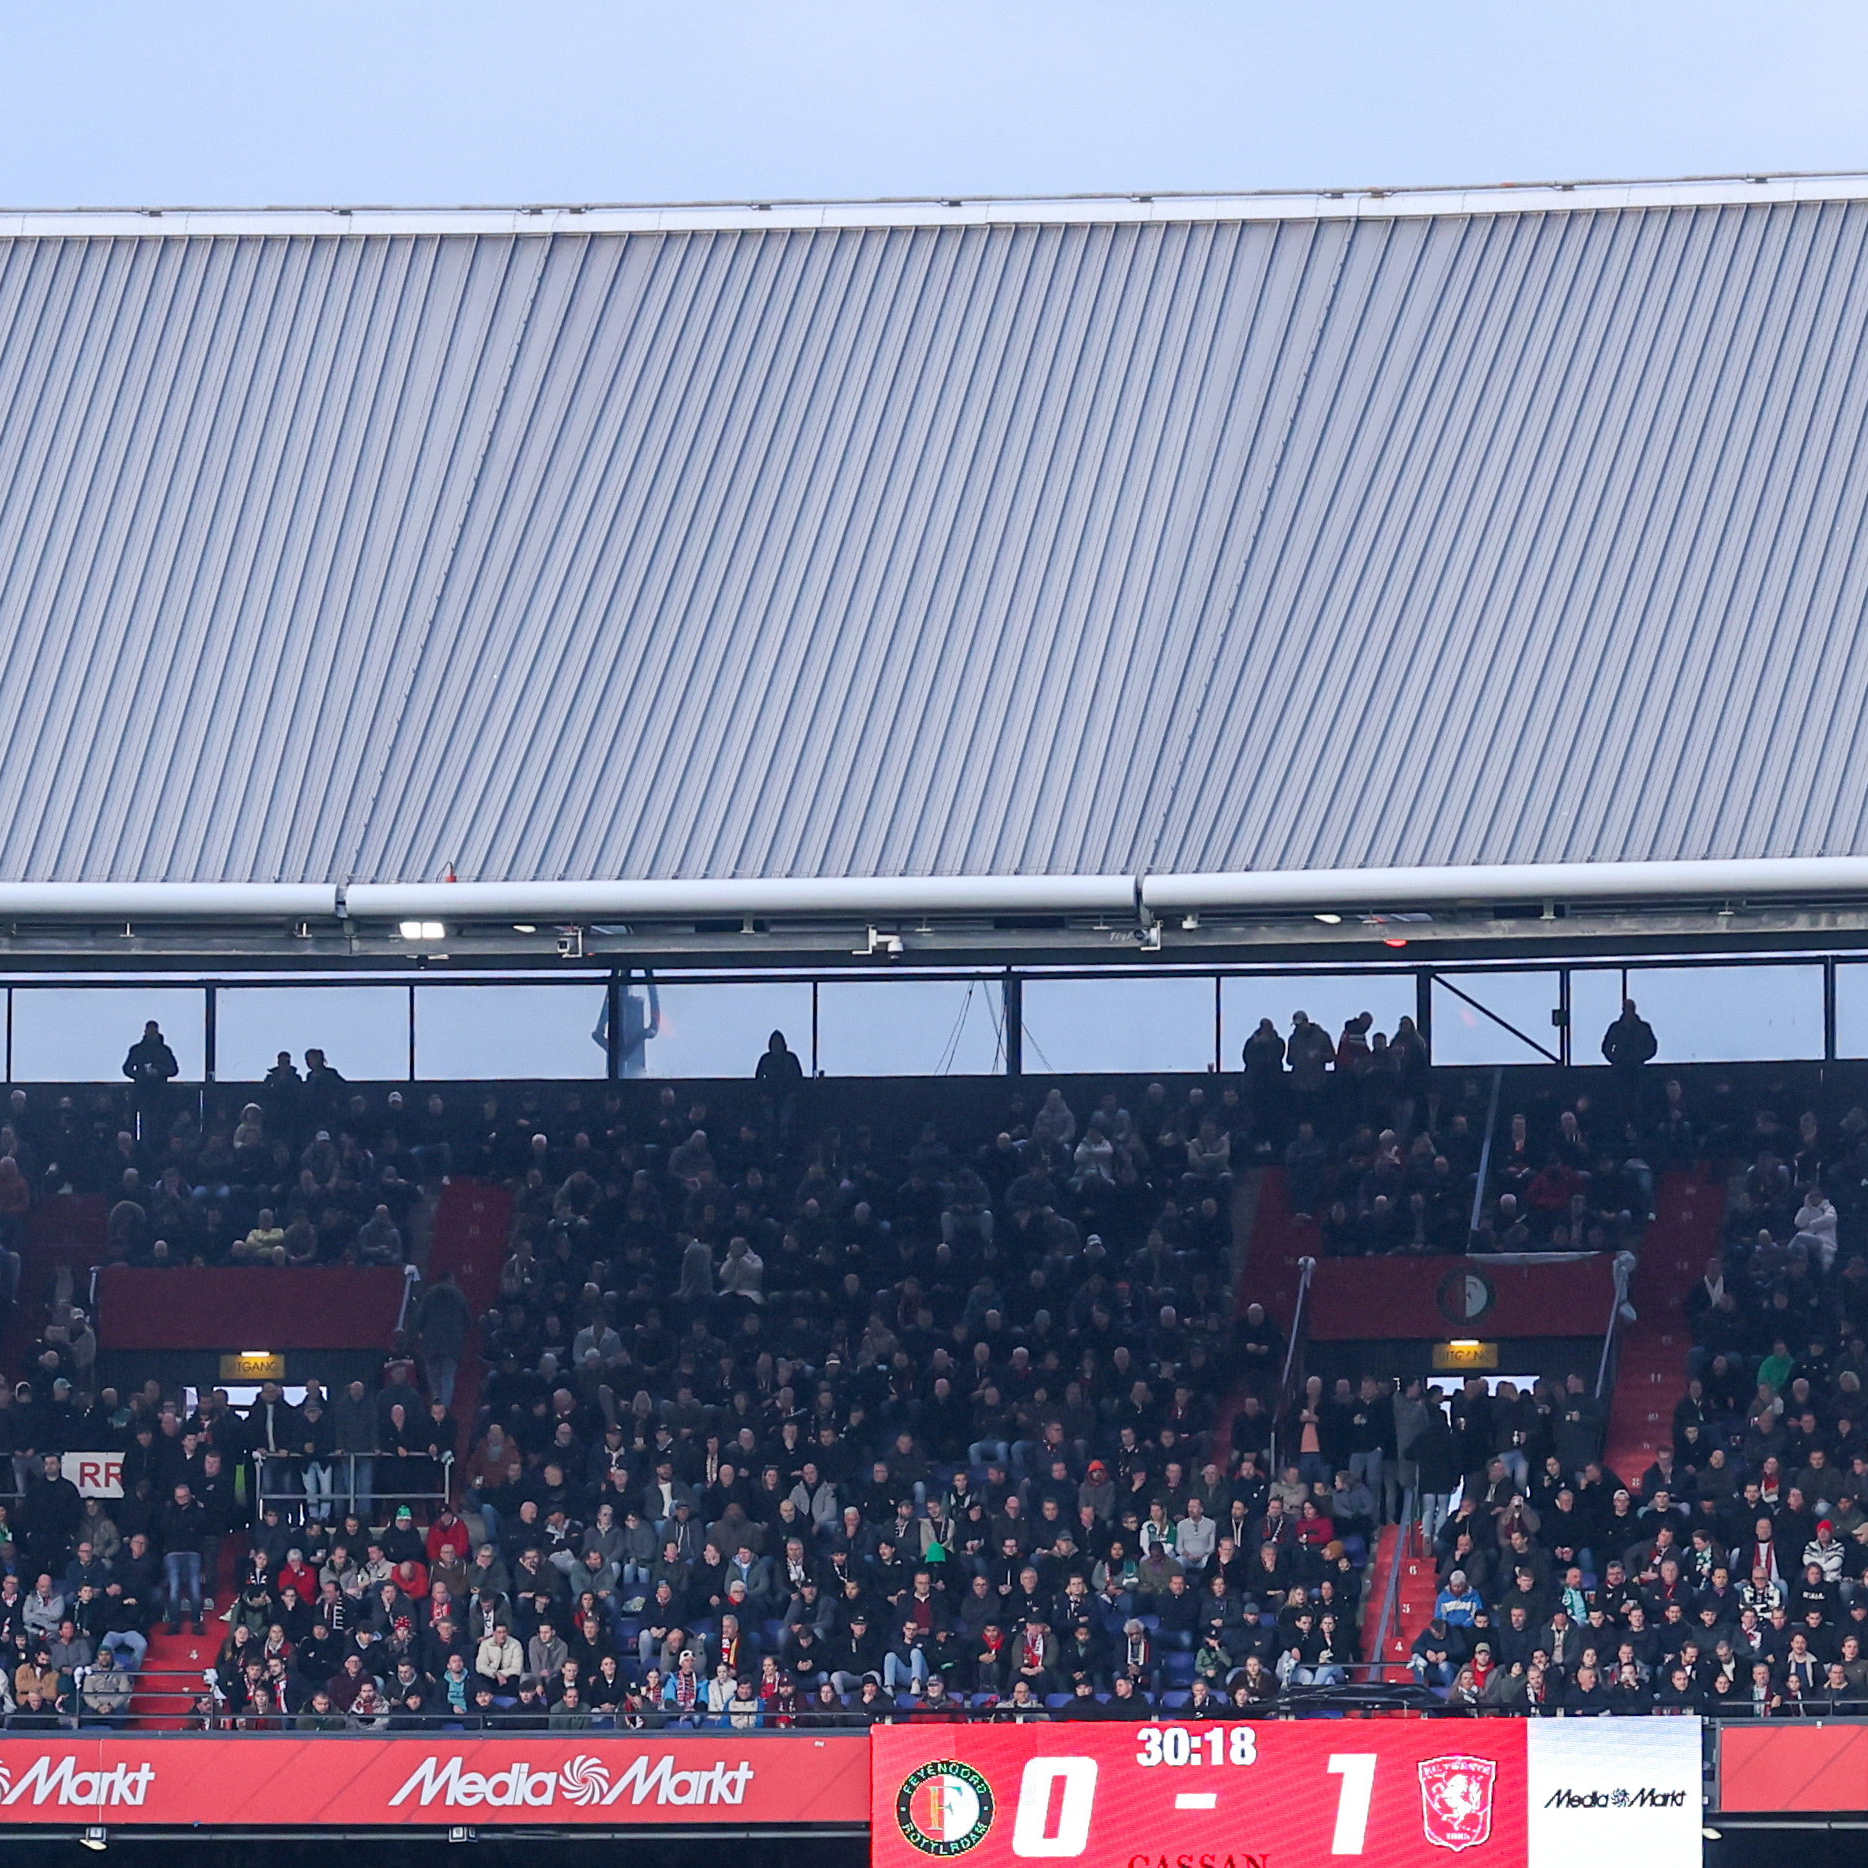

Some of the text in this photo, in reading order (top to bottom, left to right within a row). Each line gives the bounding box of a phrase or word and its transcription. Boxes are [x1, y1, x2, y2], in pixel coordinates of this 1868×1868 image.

[1409, 1565, 1417, 1575] 6
[1402, 1603, 1410, 1613] 5
[1395, 1641, 1403, 1651] 4
[1136, 1727, 1257, 1766] 30:18
[1, 1756, 155, 1806] Markt
[388, 1755, 754, 1806] Media Markt
[1012, 1756, 1099, 1857] 0
[1327, 1753, 1378, 1855] 1
